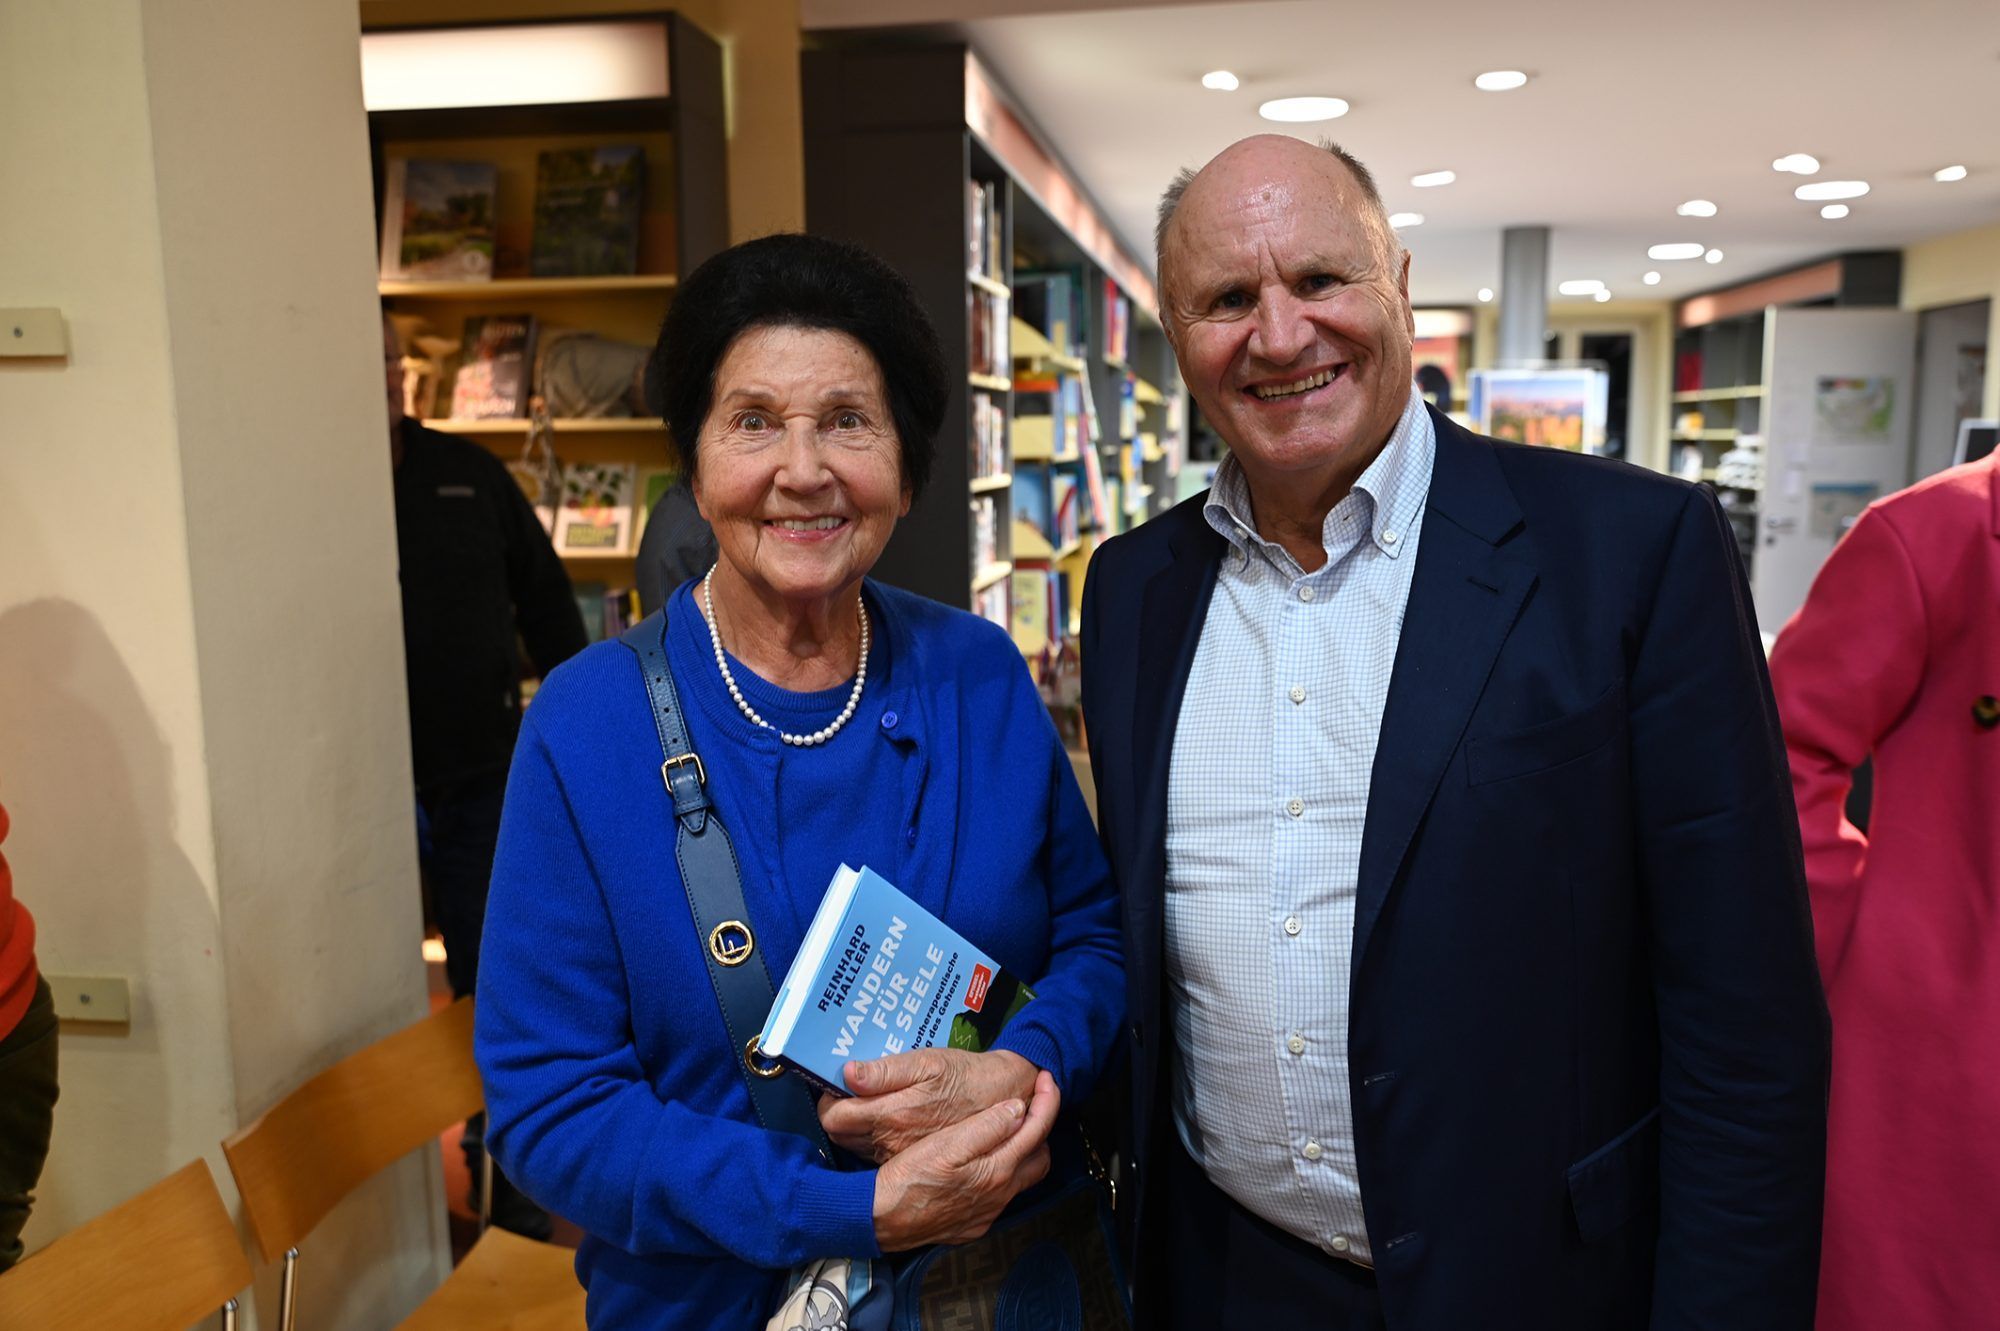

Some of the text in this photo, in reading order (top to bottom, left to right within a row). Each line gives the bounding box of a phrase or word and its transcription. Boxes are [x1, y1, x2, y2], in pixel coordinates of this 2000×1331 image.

[818, 924, 865, 1012] REINHARD
[831, 915, 907, 1057] WANDERN
[833, 941, 871, 1008] HALLER
[872, 972, 909, 1030] FÜR
[896, 942, 943, 1033] SEELE
[911, 952, 959, 1050] hotherapeutische
[929, 1017, 941, 1039] des
[938, 973, 961, 1016] Gehens
